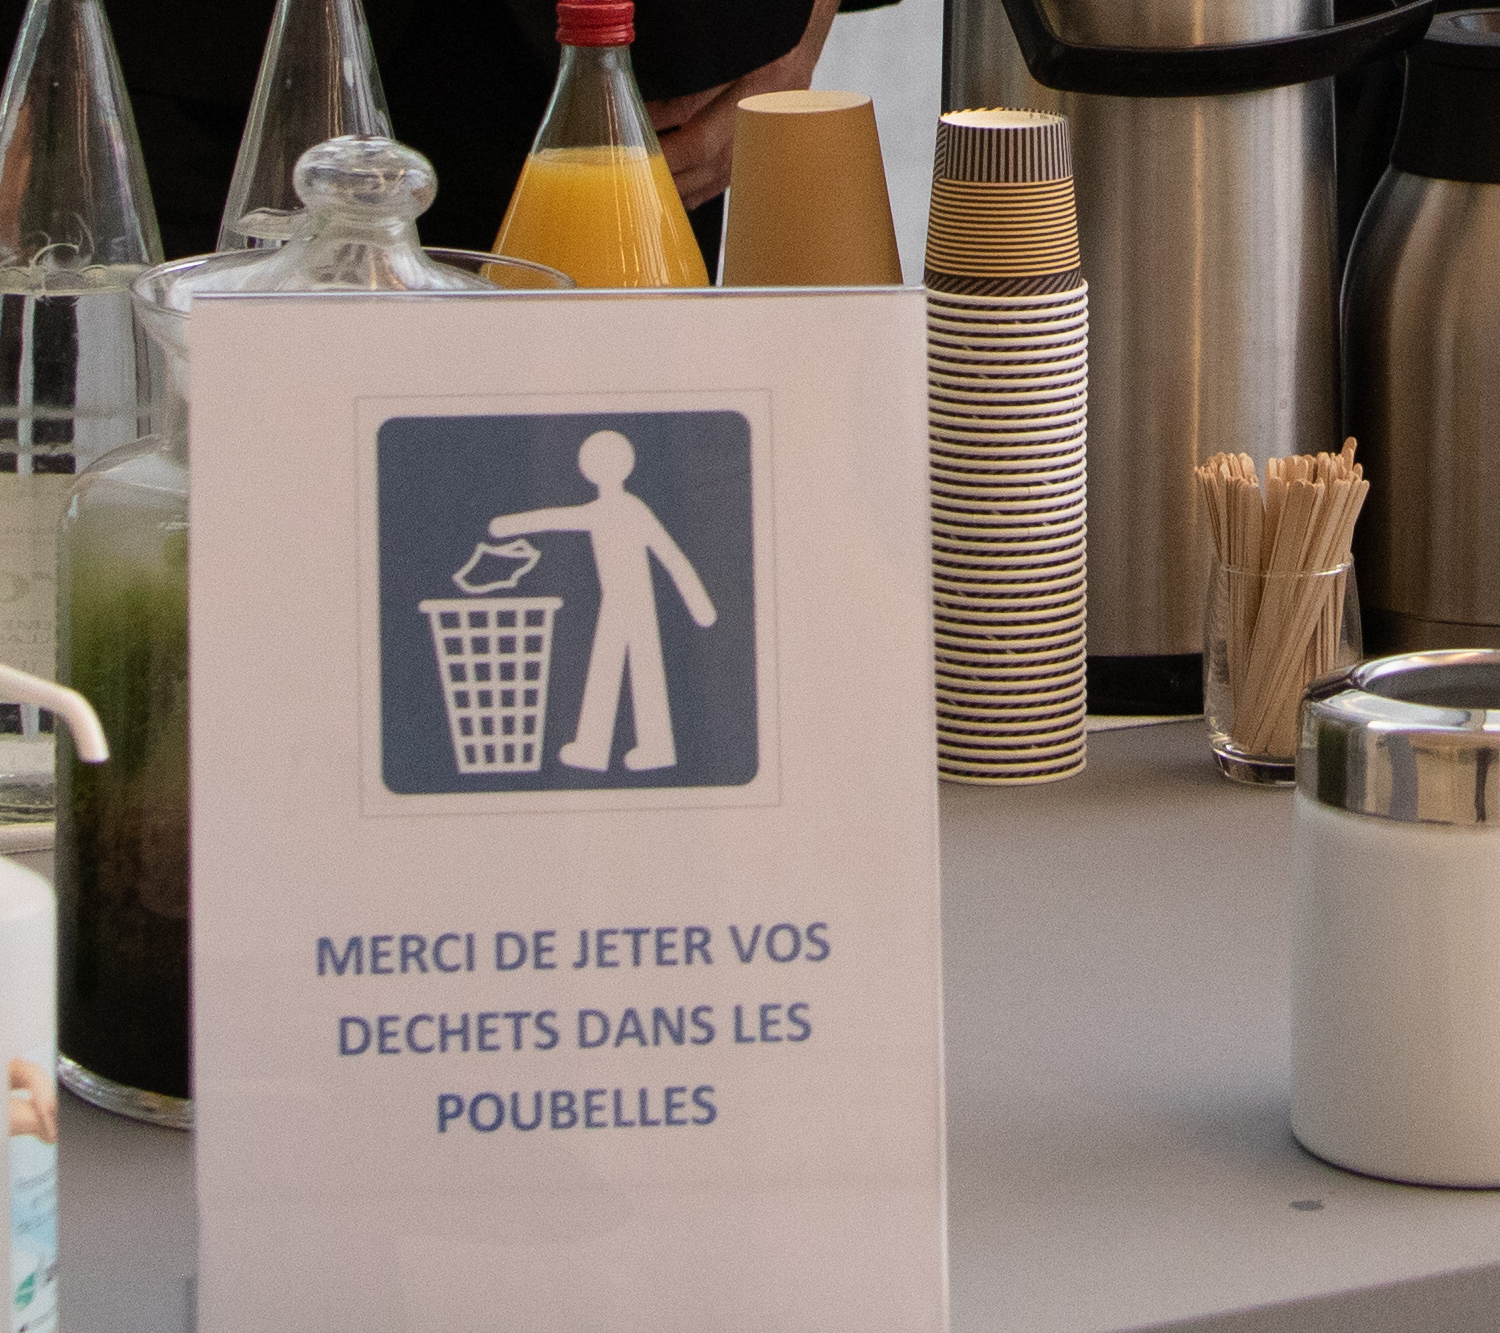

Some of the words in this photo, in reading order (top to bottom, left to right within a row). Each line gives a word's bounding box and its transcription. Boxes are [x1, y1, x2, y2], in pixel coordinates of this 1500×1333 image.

[317, 933, 475, 975] MERCI
[495, 931, 554, 971] DE
[575, 926, 711, 968] JETER
[731, 923, 829, 963] VOS
[338, 1010, 560, 1057] DECHETS
[578, 1006, 715, 1049] DANS
[734, 1003, 811, 1043] LES
[436, 1085, 717, 1134] POUBELLES
